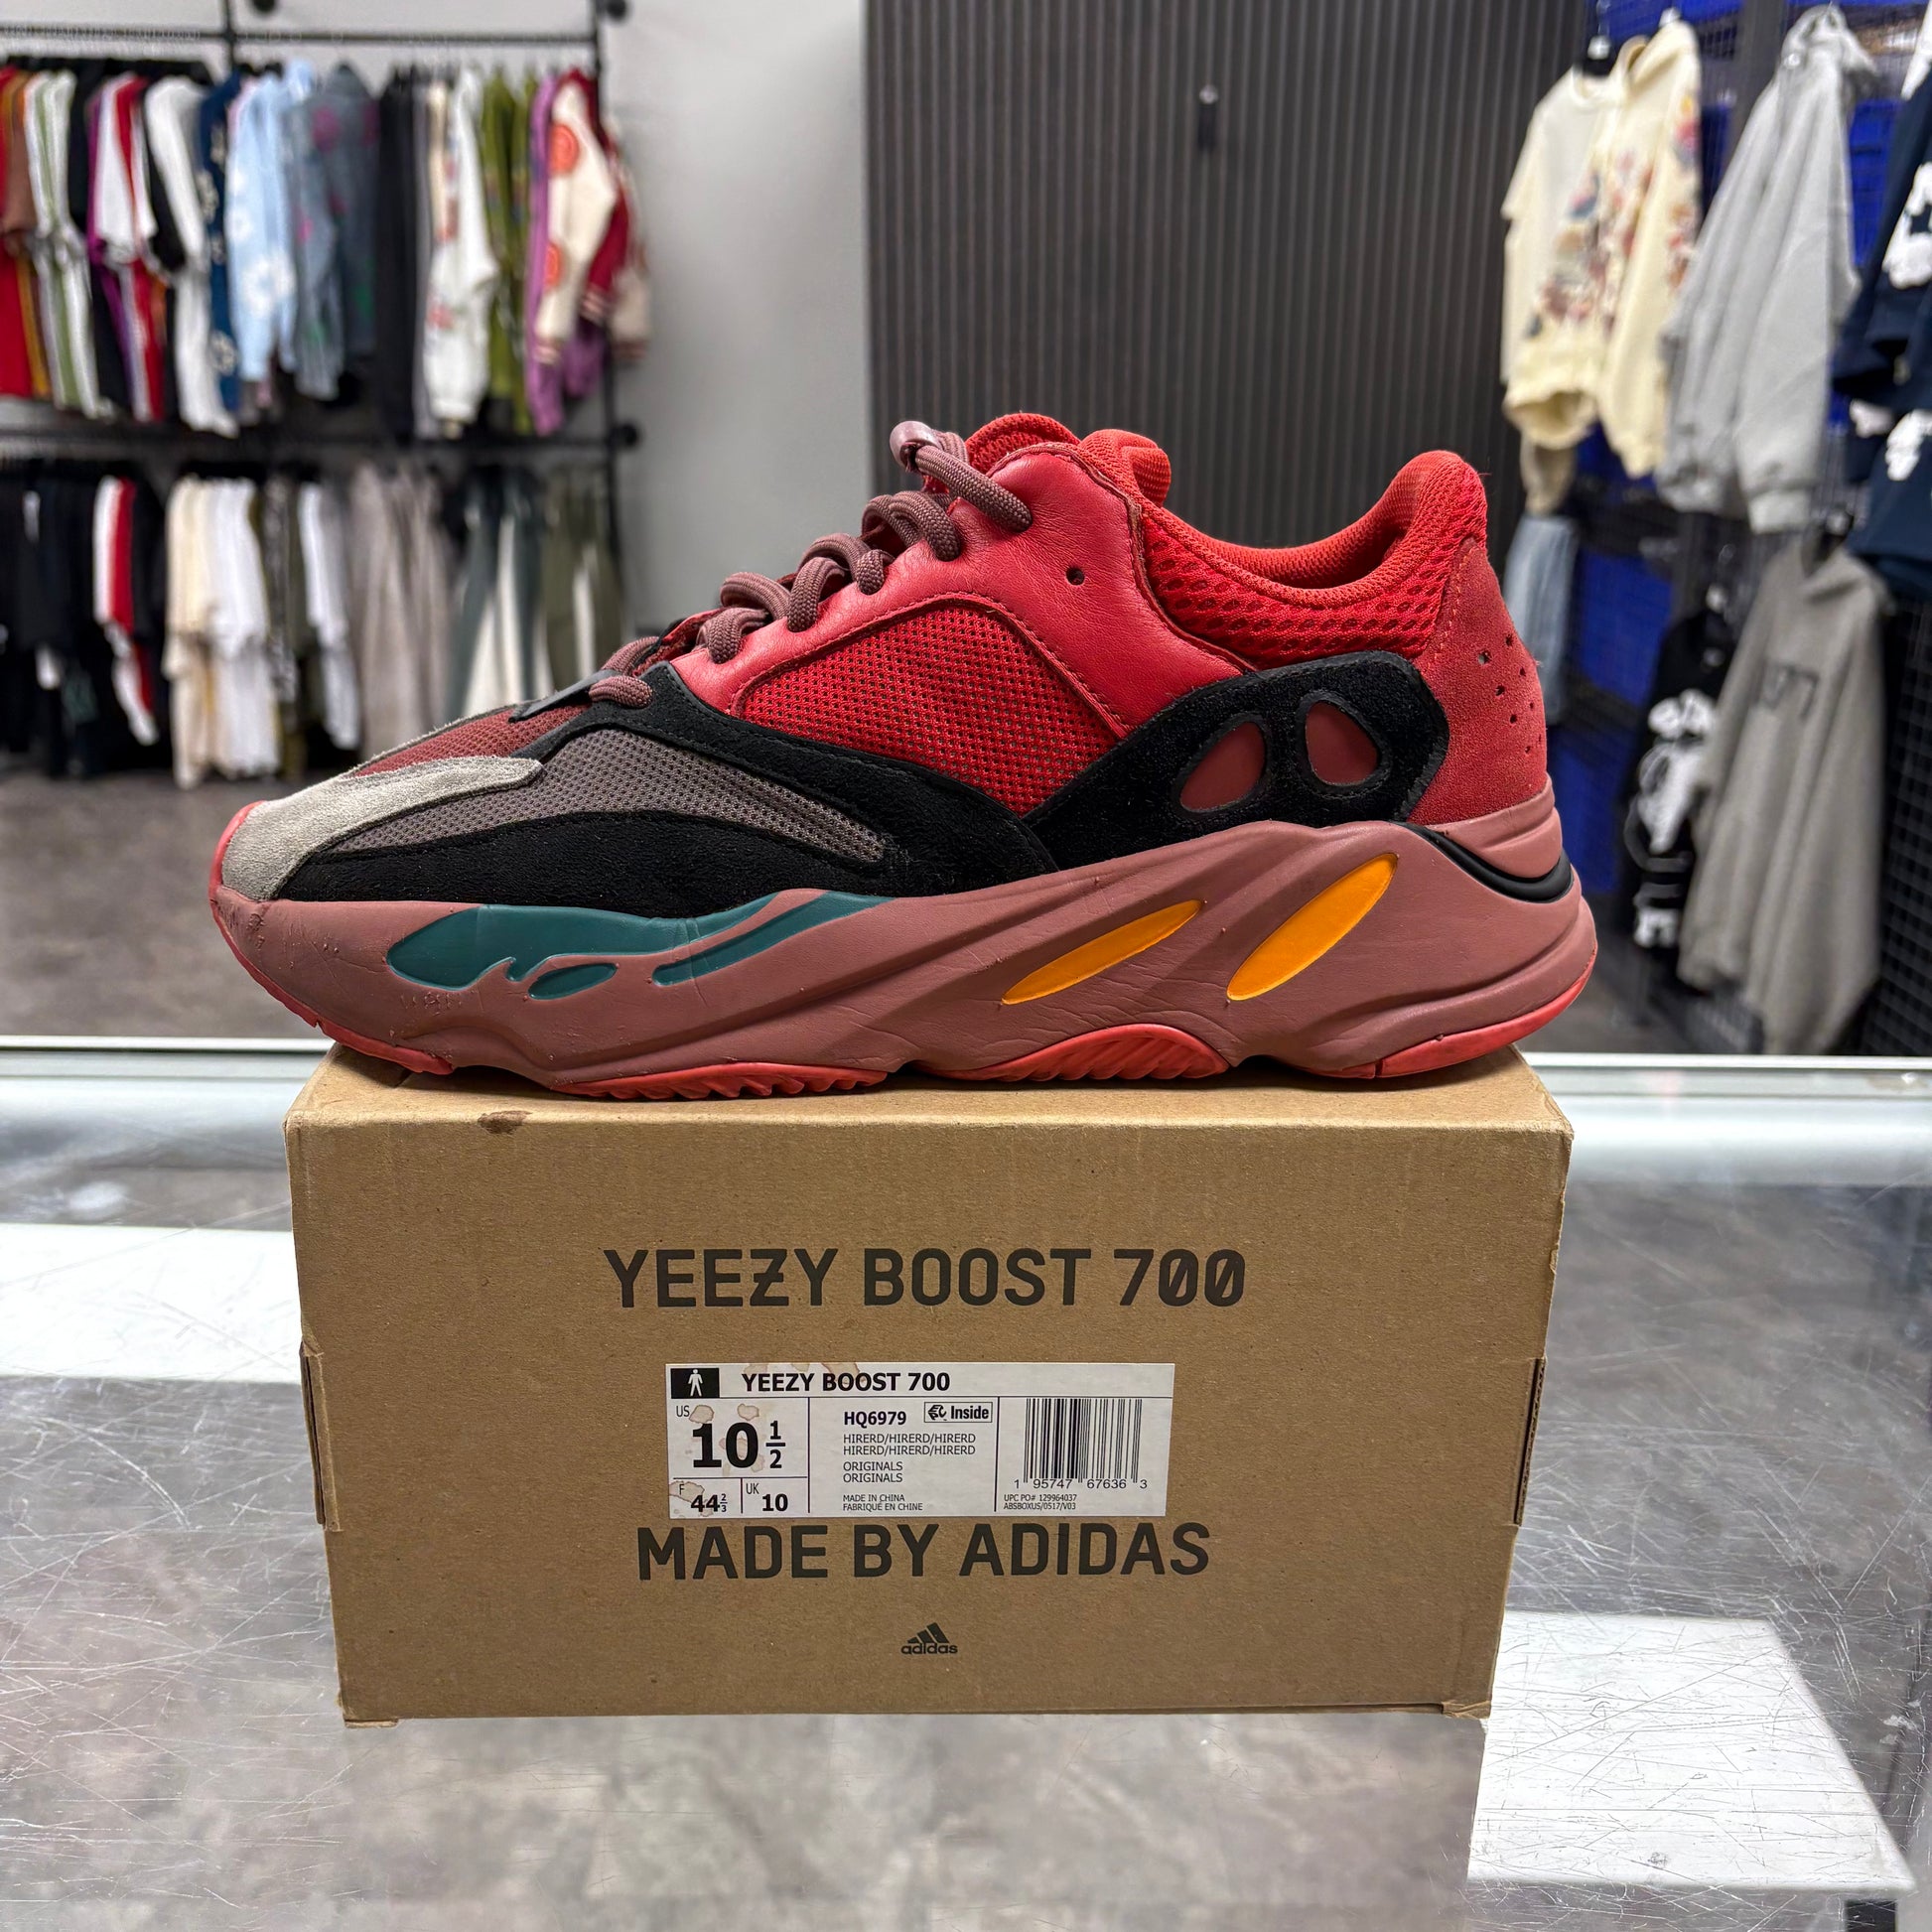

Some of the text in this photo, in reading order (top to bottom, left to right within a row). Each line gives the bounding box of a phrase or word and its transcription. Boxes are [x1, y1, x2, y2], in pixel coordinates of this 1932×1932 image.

[604, 1248, 1246, 1309] YEEZY BOOST 700
[741, 1372, 950, 1392] YEEZY BOOST 700
[675, 1405, 690, 1418] US
[950, 1405, 990, 1420] Inside
[844, 1411, 906, 1429] HQ6979
[692, 1421, 759, 1469] 10
[843, 1433, 976, 1445] HIRERD/HIRERD/HIRERD
[843, 1445, 976, 1456] HIRERD/HIRERD/HIRERD
[843, 1461, 903, 1471] ORIGINALS
[843, 1472, 903, 1483] ORIGINALS
[1014, 1478, 1148, 1489] 1 95747 67636 3
[746, 1482, 759, 1495] UK
[690, 1494, 721, 1513] 44
[761, 1493, 789, 1512] 10
[885, 1502, 896, 1511] EN
[897, 1502, 923, 1511] CHINE
[637, 1522, 1211, 1581] MADE BY ADIDAS
[900, 1642, 958, 1655] adidas
